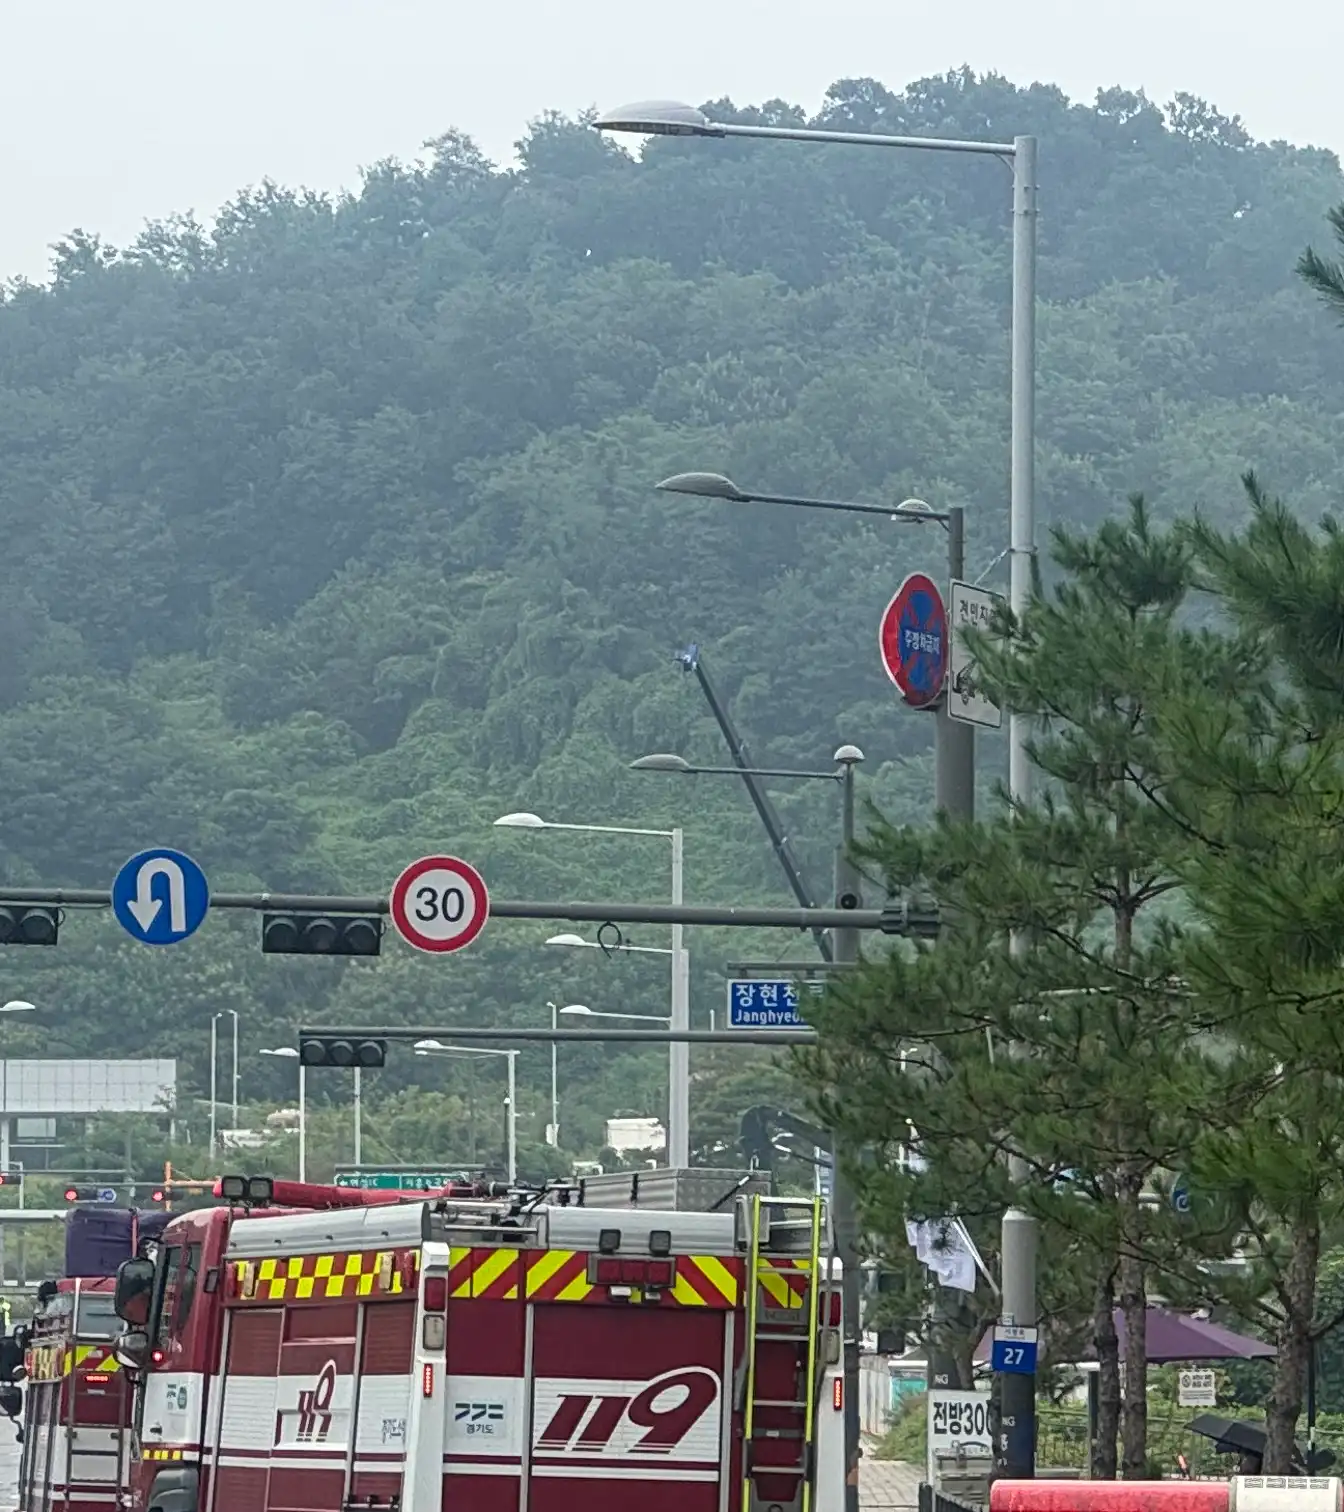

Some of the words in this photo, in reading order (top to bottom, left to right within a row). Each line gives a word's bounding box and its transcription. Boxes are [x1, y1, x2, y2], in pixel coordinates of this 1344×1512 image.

[415, 886, 465, 922] 30
[1004, 1347, 1025, 1365] 27
[533, 1371, 718, 1455] 119
